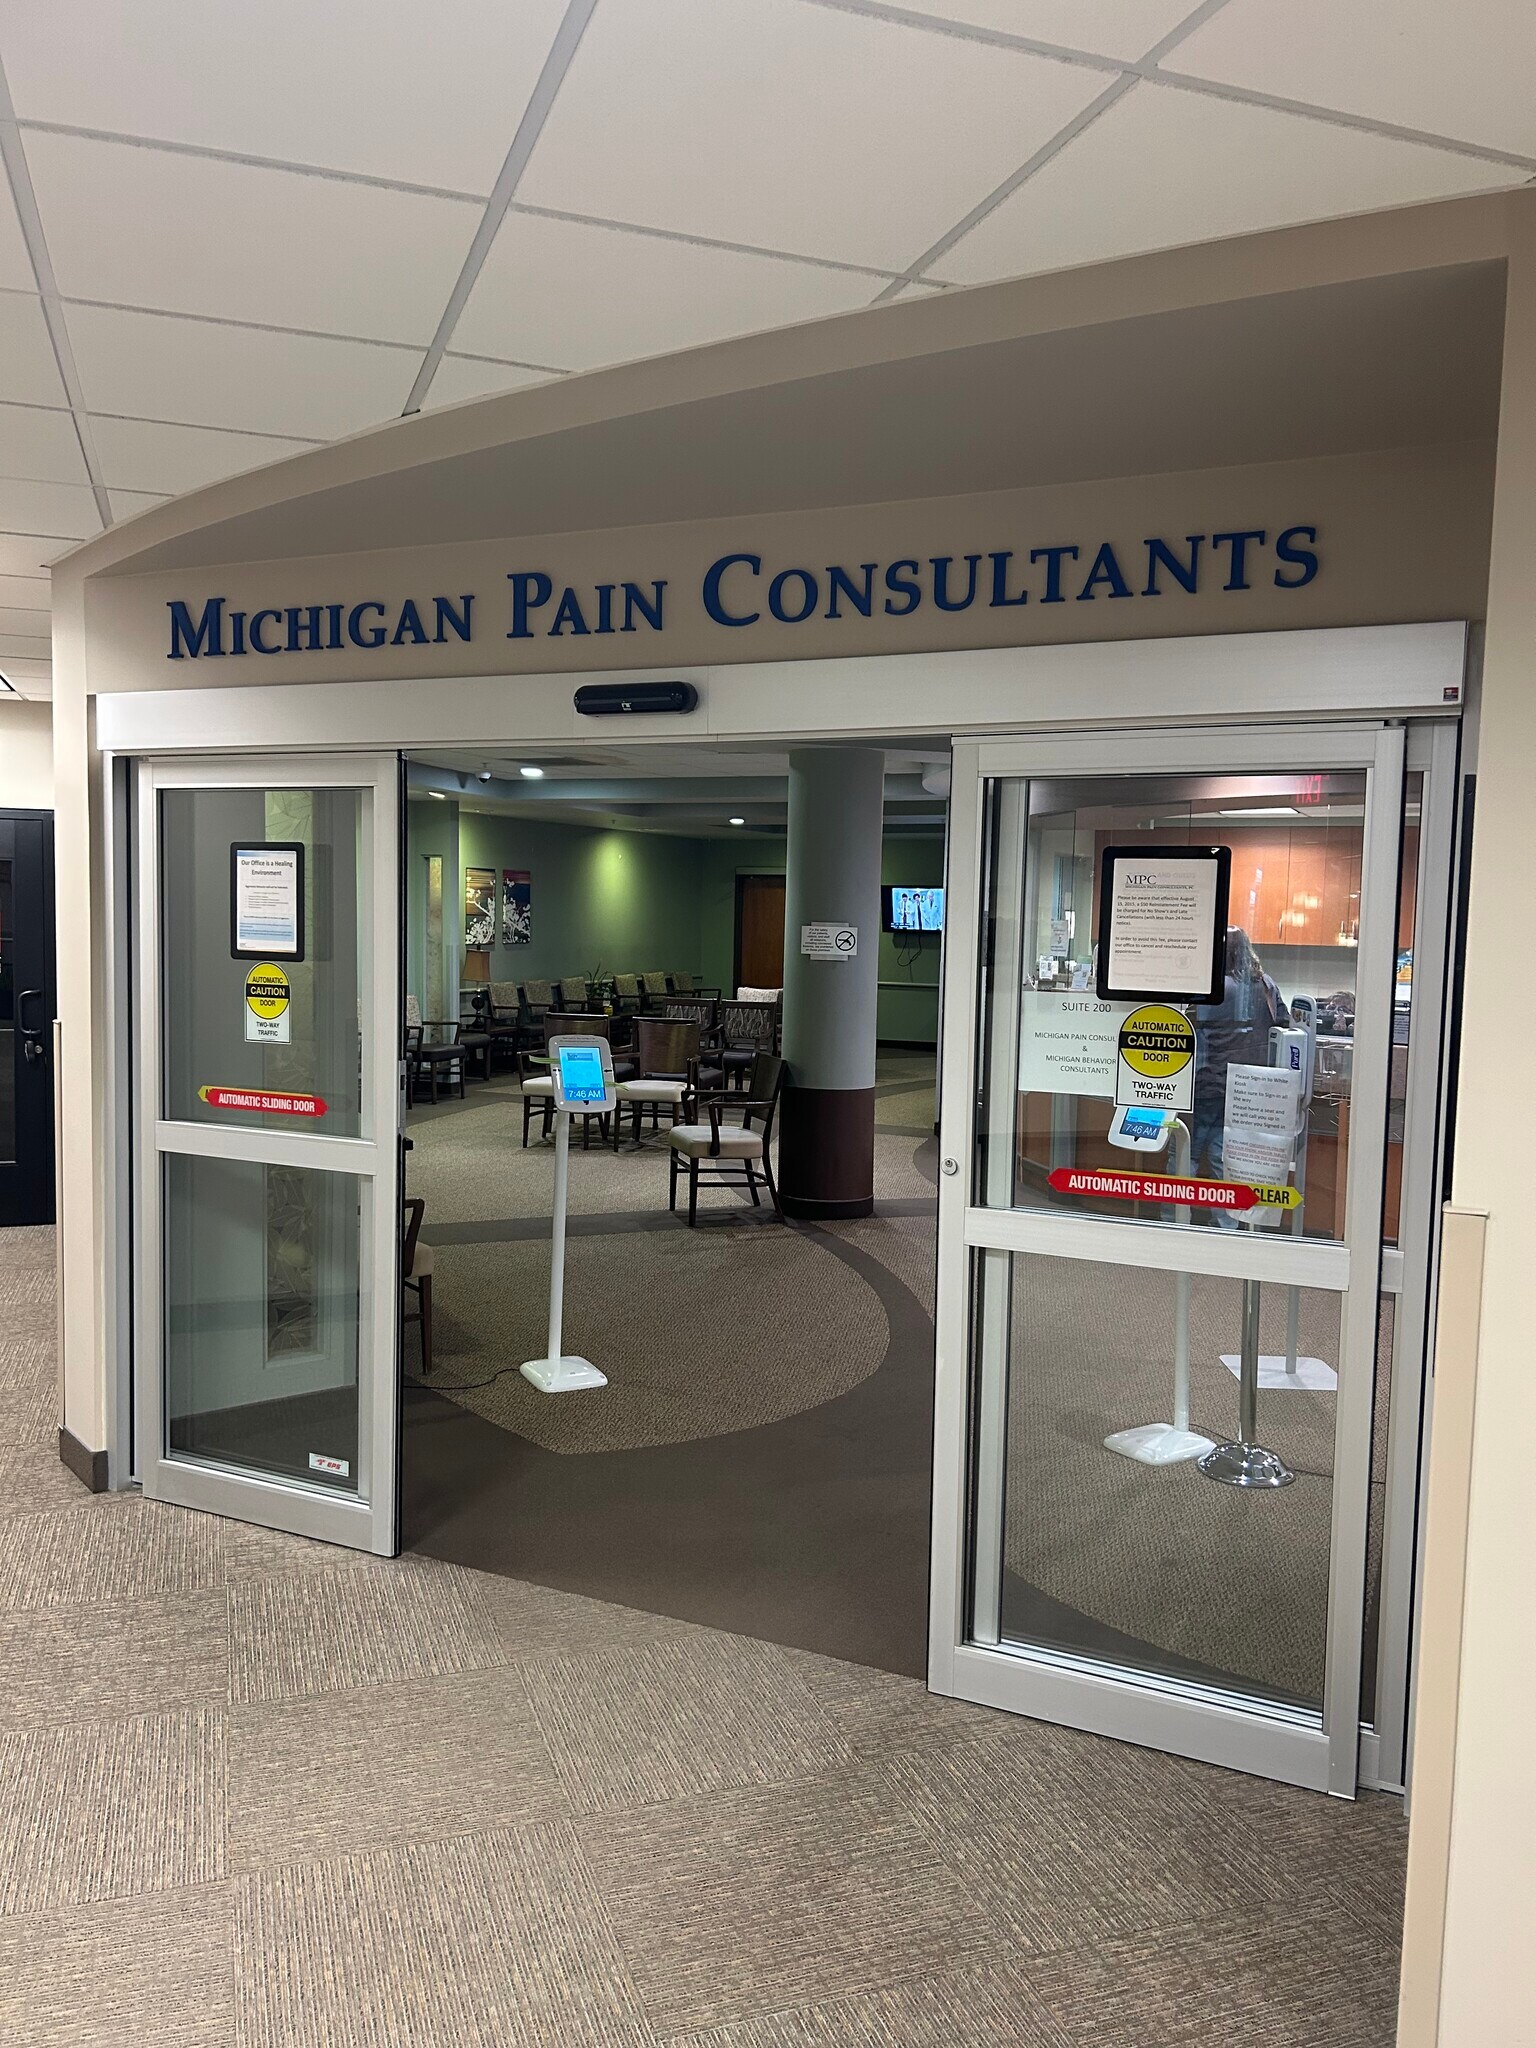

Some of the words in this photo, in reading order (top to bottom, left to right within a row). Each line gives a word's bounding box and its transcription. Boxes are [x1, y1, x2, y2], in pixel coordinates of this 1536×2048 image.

[167, 595, 474, 659] MICHIGAN
[507, 572, 669, 638] PAIN
[703, 525, 1321, 626] CONSULTANTS
[1126, 875, 1157, 884] MPC
[250, 987, 285, 996] CAUTION
[1062, 1002, 1090, 1011] SUITE
[1093, 1004, 1112, 1012] 200
[1132, 1022, 1185, 1032] AUTOMATIC
[1128, 1035, 1186, 1048] CAUTION
[1143, 1053, 1169, 1062] DOOR
[1060, 1066, 1109, 1074] CONSULTANTS
[1132, 1081, 1177, 1091] TWO-WAY
[1135, 1090, 1173, 1100] TRAFFIC
[219, 1093, 260, 1107] AUTOMATIC
[262, 1097, 292, 1110] SLIDING
[293, 1100, 315, 1112] DOOR
[1126, 1124, 1143, 1134] 7:46
[1143, 1126, 1157, 1136] AM
[1069, 1175, 1141, 1194] AUTOMATIC
[1144, 1181, 1195, 1199] SLIDING
[1198, 1187, 1235, 1204] DOOR
